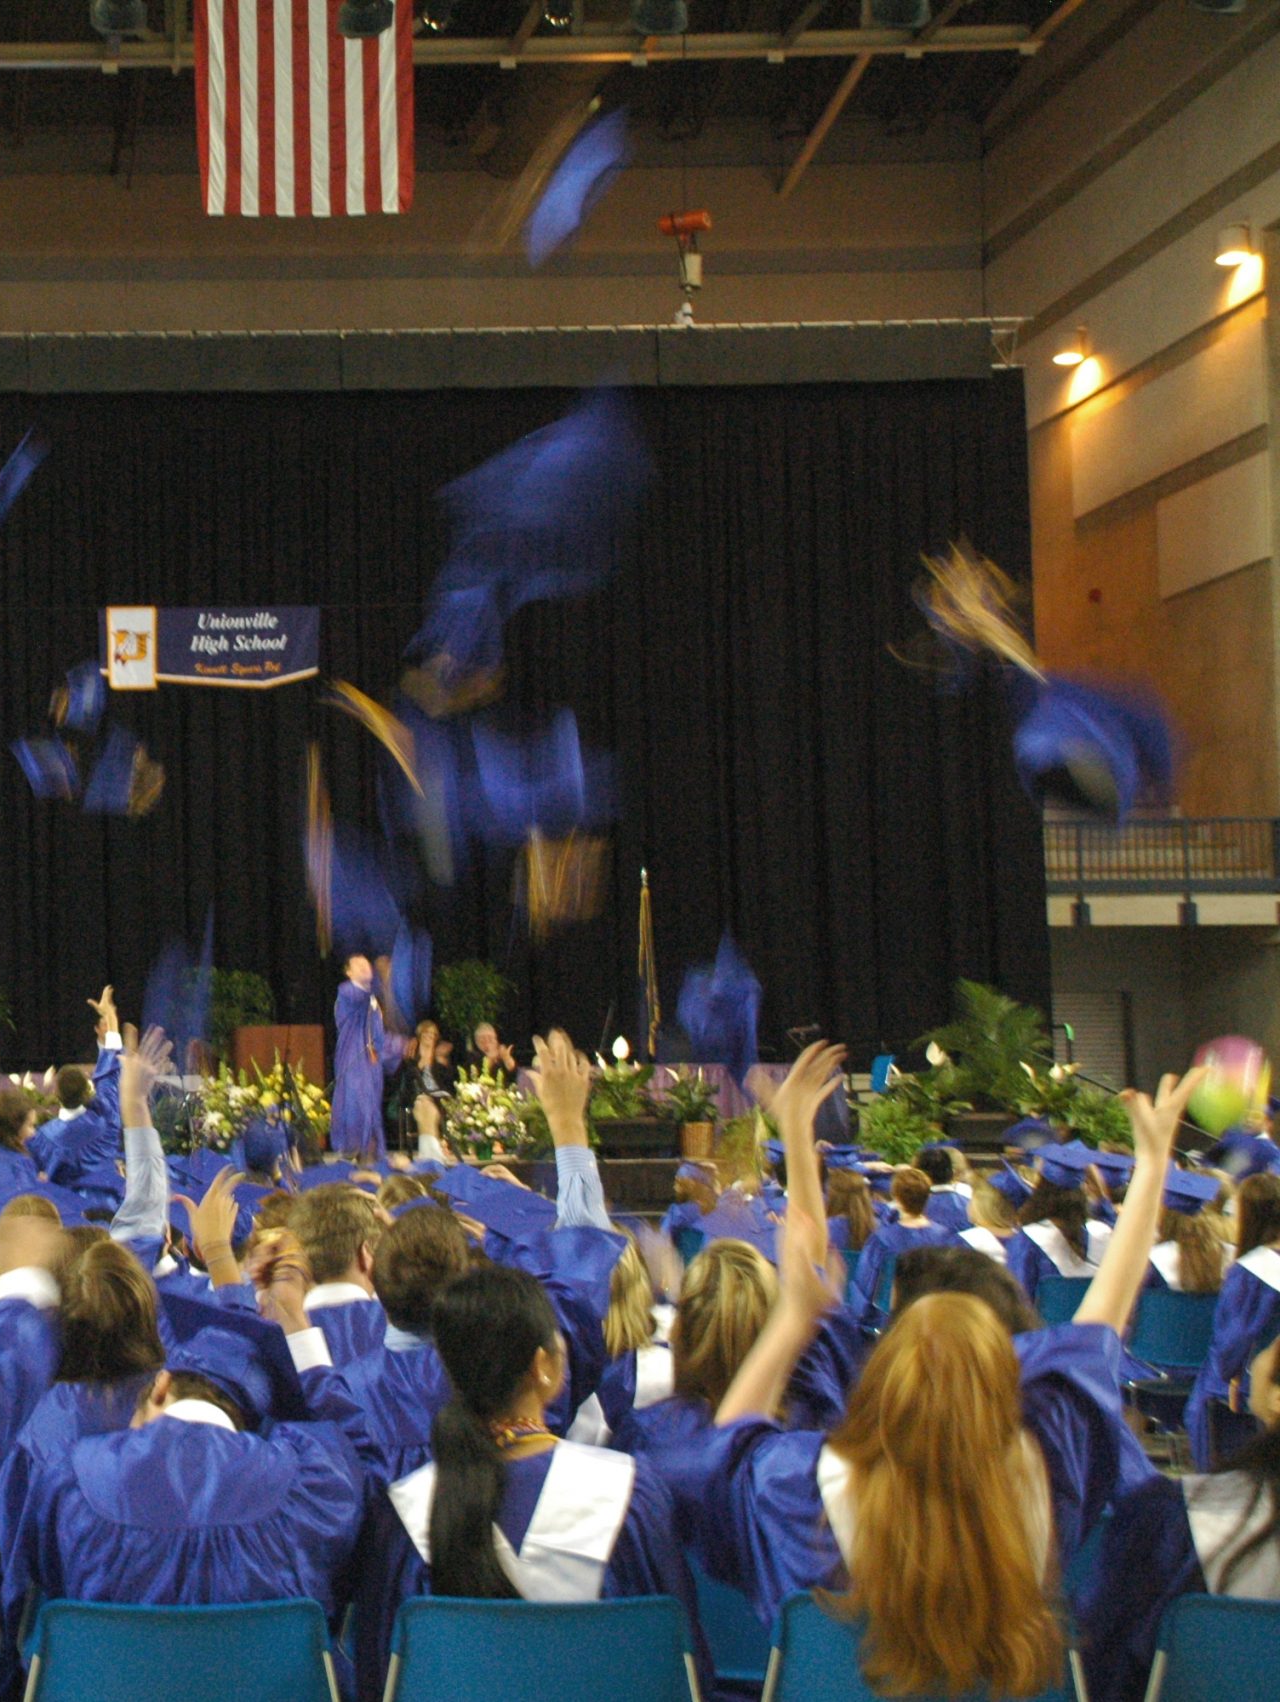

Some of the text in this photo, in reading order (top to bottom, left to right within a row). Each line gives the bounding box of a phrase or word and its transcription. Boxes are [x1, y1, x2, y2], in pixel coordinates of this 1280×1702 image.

[197, 612, 279, 631] Unionville
[190, 633, 288, 656] High School
